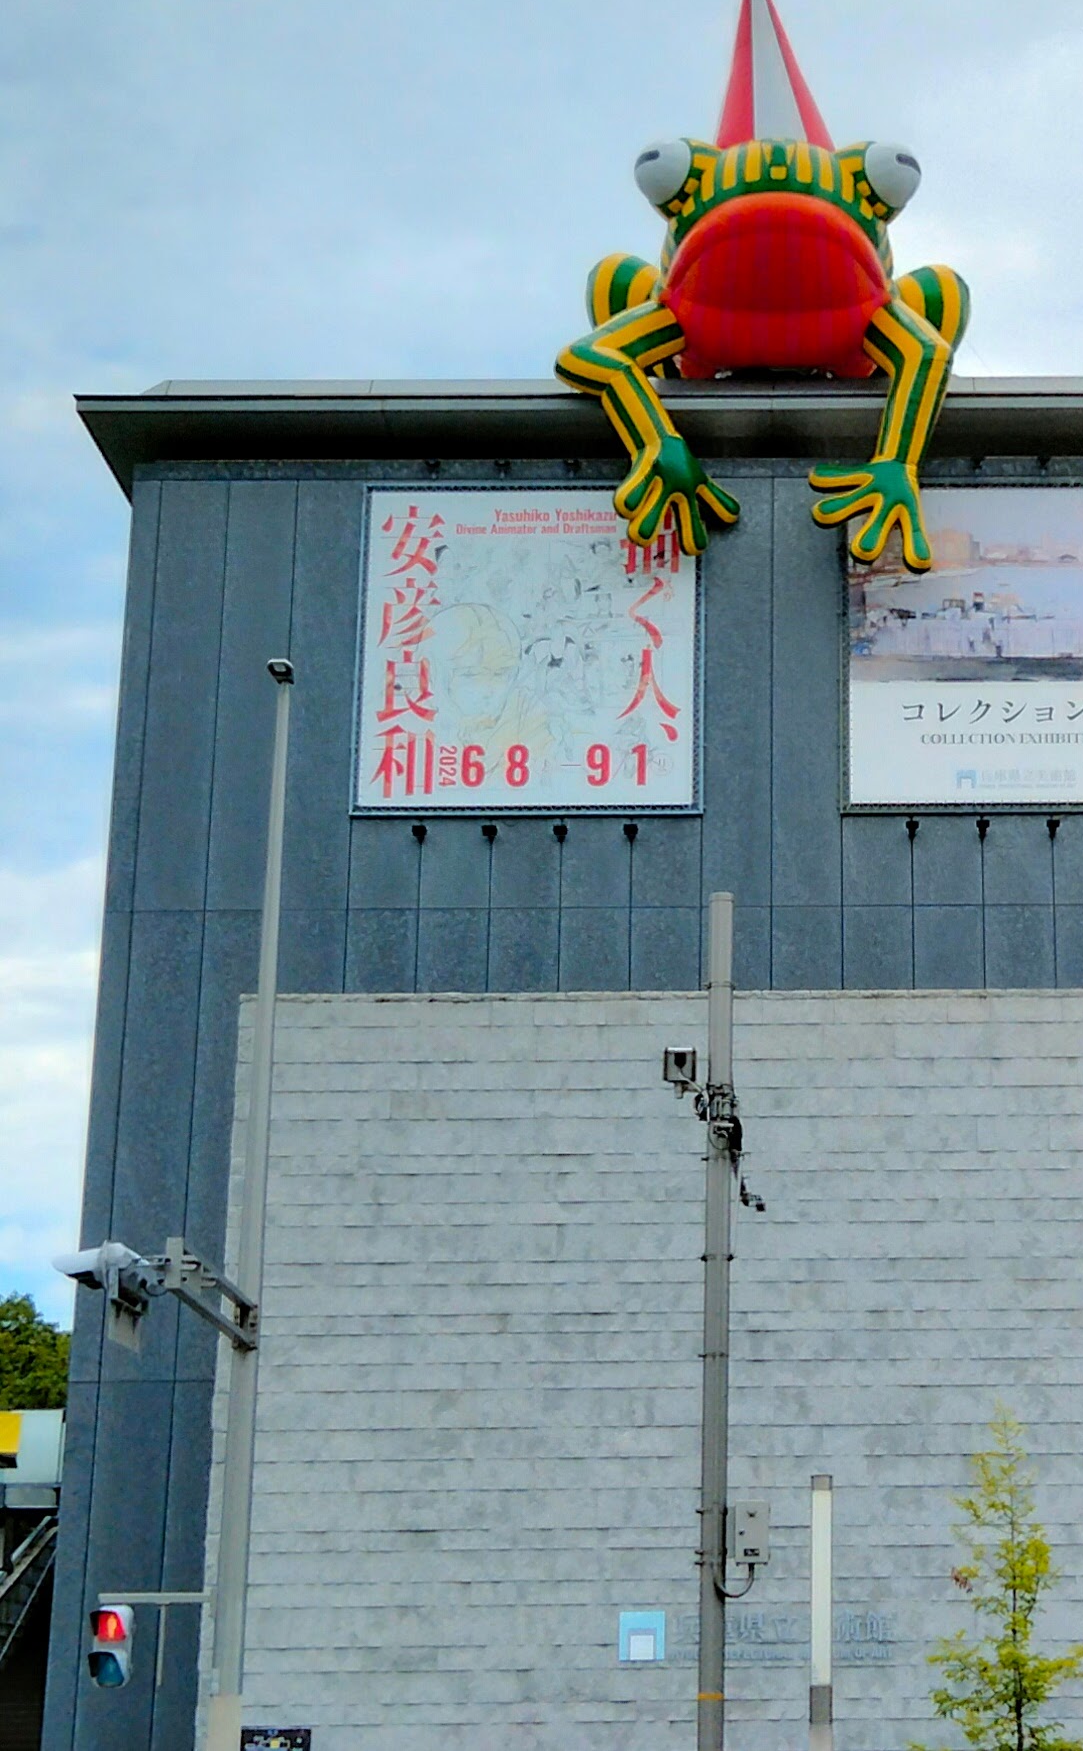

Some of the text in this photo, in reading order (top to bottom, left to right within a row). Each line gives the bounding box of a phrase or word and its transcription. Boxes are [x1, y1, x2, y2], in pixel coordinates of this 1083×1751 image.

[494, 508, 617, 522] Yasuhiko Yoshikazu
[456, 523, 617, 535] Divine Animator and Draftsman
[370, 505, 446, 798] 安彦良和
[921, 733, 1016, 745] COLLECTION
[438, 745, 458, 787] 2024
